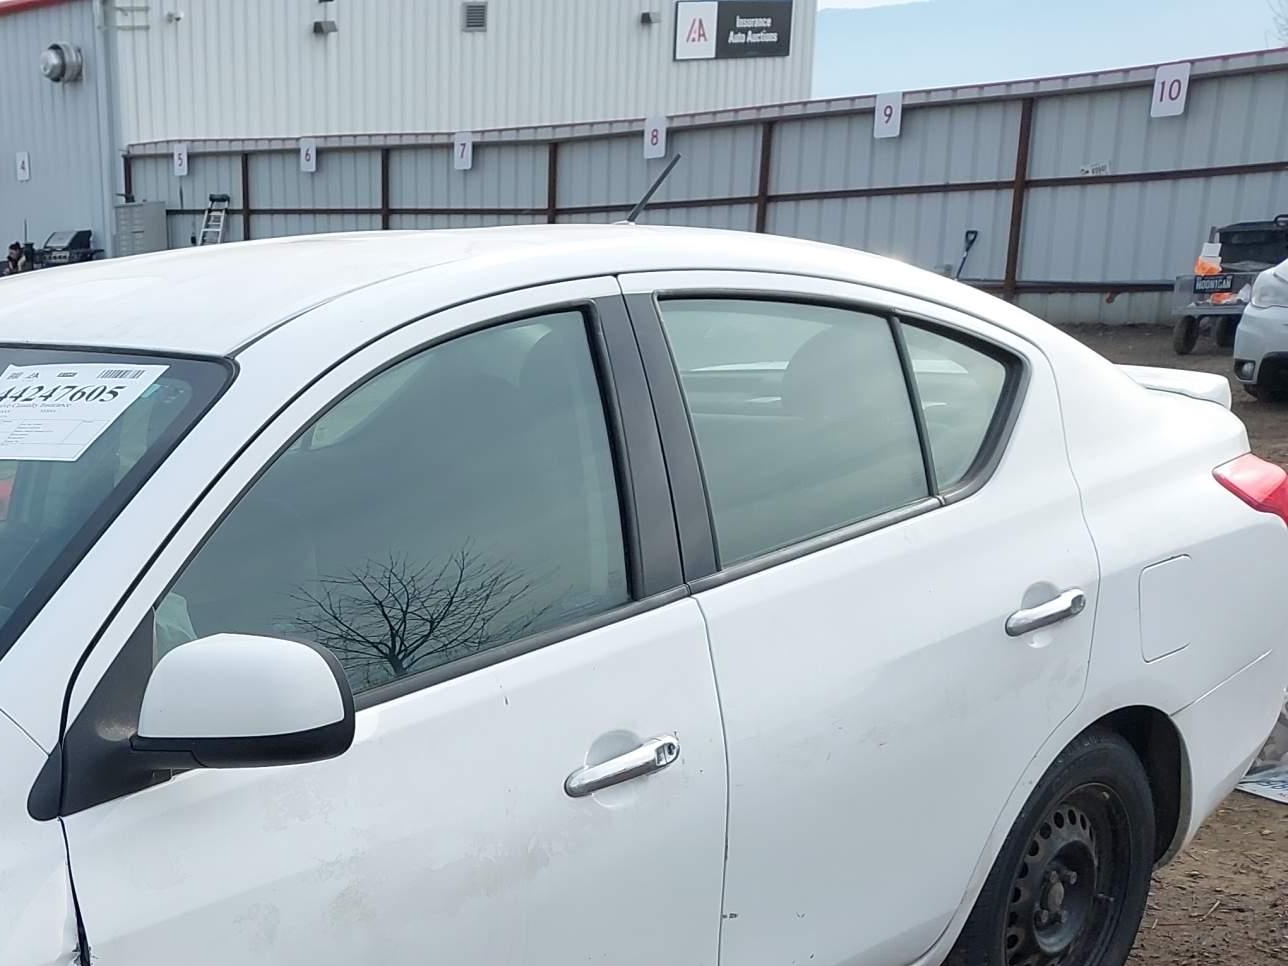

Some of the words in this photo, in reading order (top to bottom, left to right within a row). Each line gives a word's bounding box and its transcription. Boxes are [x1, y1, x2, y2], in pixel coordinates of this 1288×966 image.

[736, 15, 772, 27] Insurance
[728, 30, 746, 43] Auto
[746, 29, 778, 42] Auctions
[1159, 79, 1182, 102] 10
[882, 104, 893, 124] 9
[650, 128, 659, 146] 8
[304, 148, 311, 162] 6
[460, 142, 466, 159] 7
[178, 152, 184, 167] 5
